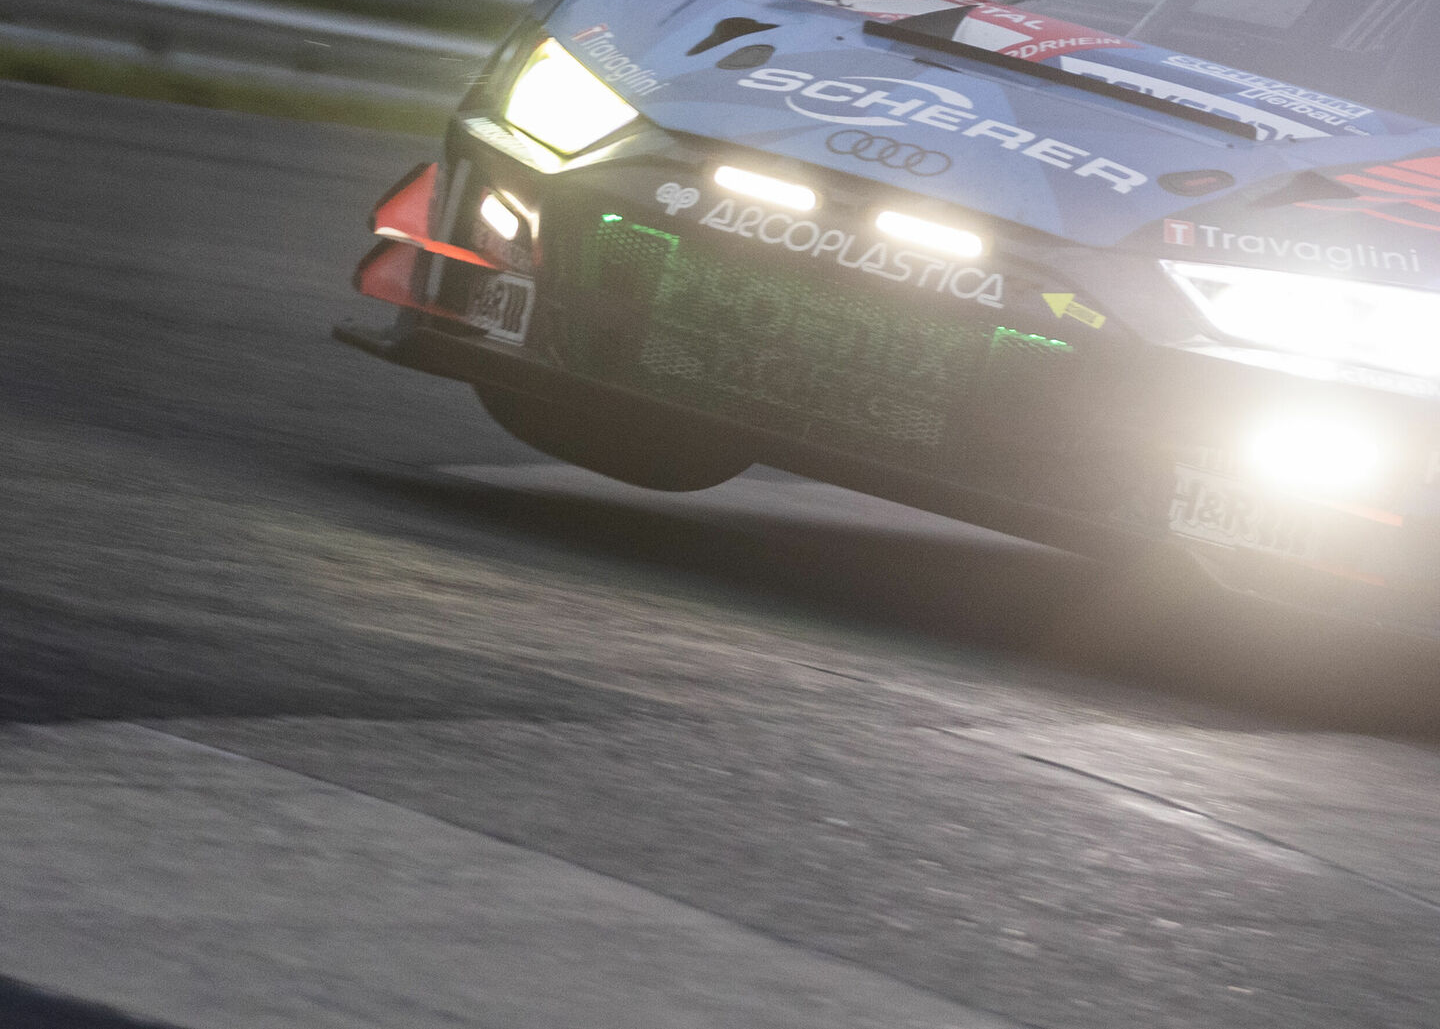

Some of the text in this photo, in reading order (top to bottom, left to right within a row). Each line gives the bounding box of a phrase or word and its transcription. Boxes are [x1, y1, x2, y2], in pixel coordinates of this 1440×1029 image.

[580, 32, 671, 96] Travaglini
[737, 68, 1150, 194] SCHERER
[699, 198, 1006, 309] ARCOPLASTICA
[1199, 225, 1421, 273] Travaglini
